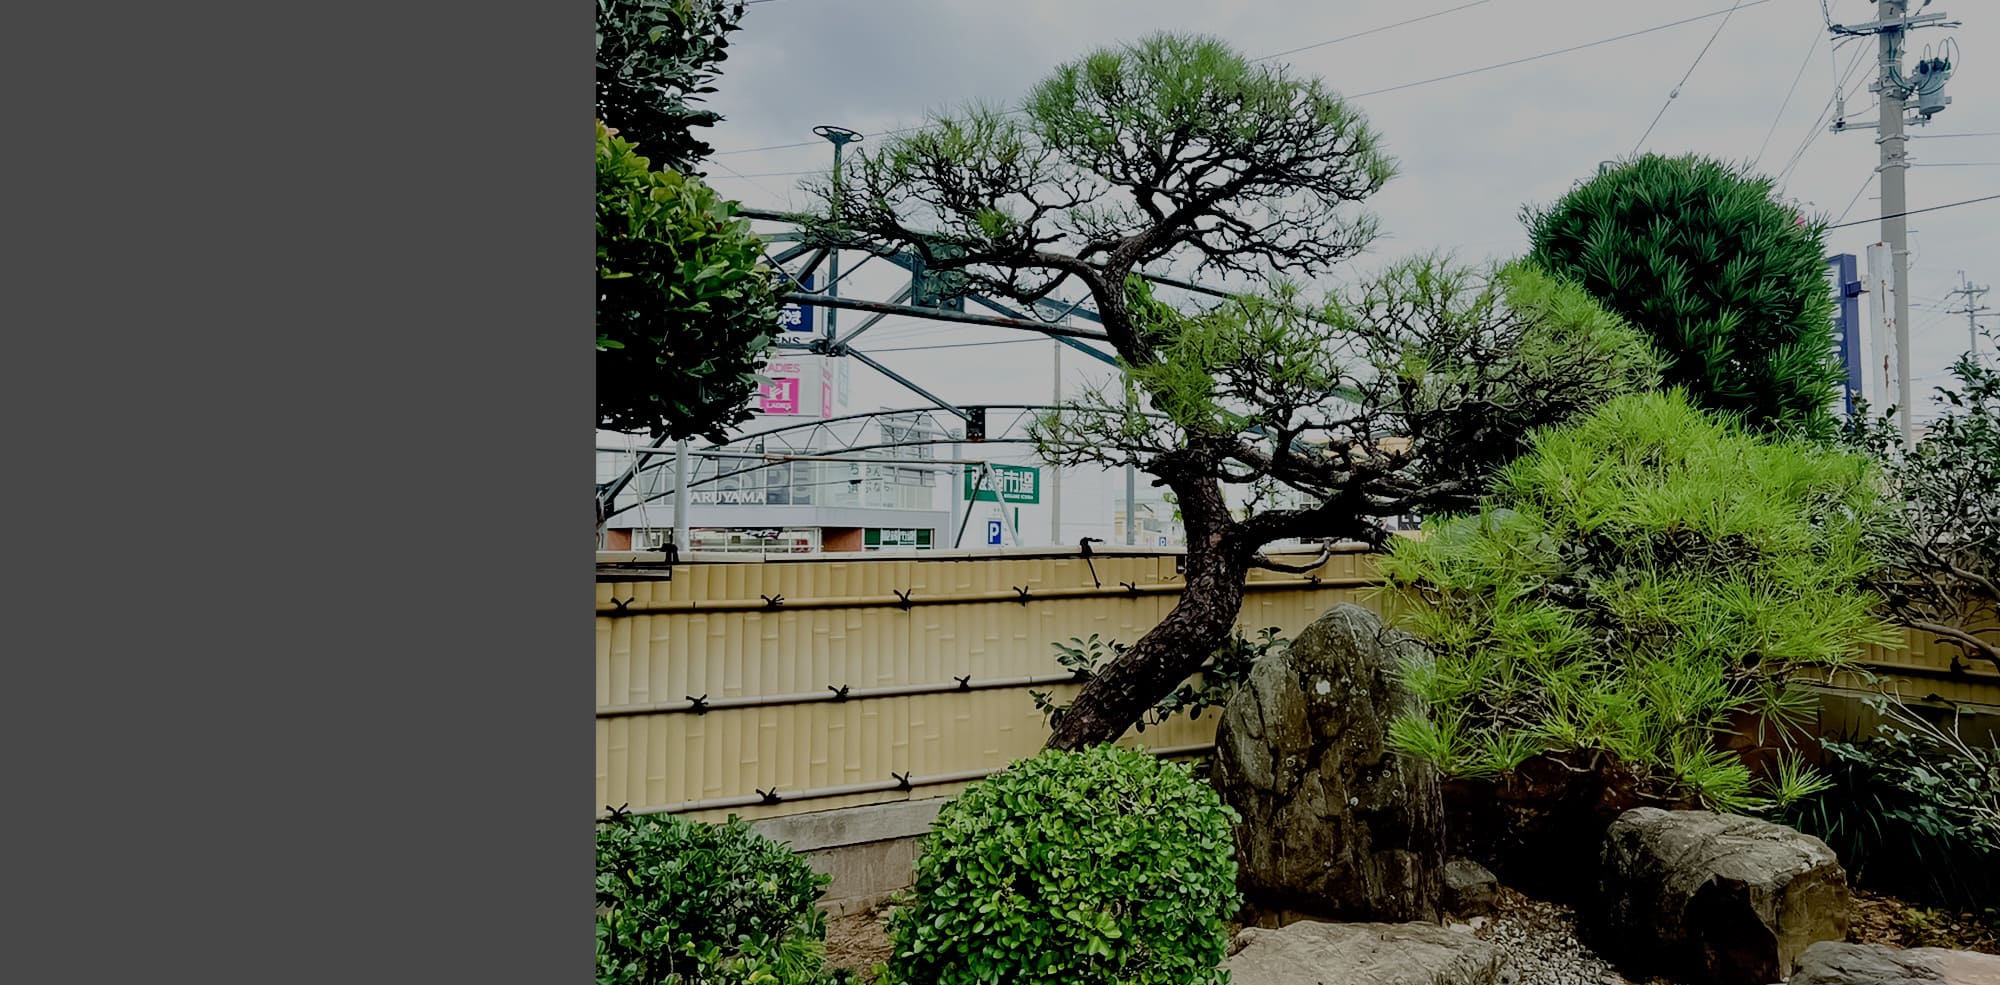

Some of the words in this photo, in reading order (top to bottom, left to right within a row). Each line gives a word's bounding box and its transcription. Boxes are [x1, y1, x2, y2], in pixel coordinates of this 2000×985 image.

[766, 363, 801, 374] ADIES
[688, 491, 766, 503] ARUYAMA
[989, 523, 1000, 543] P
